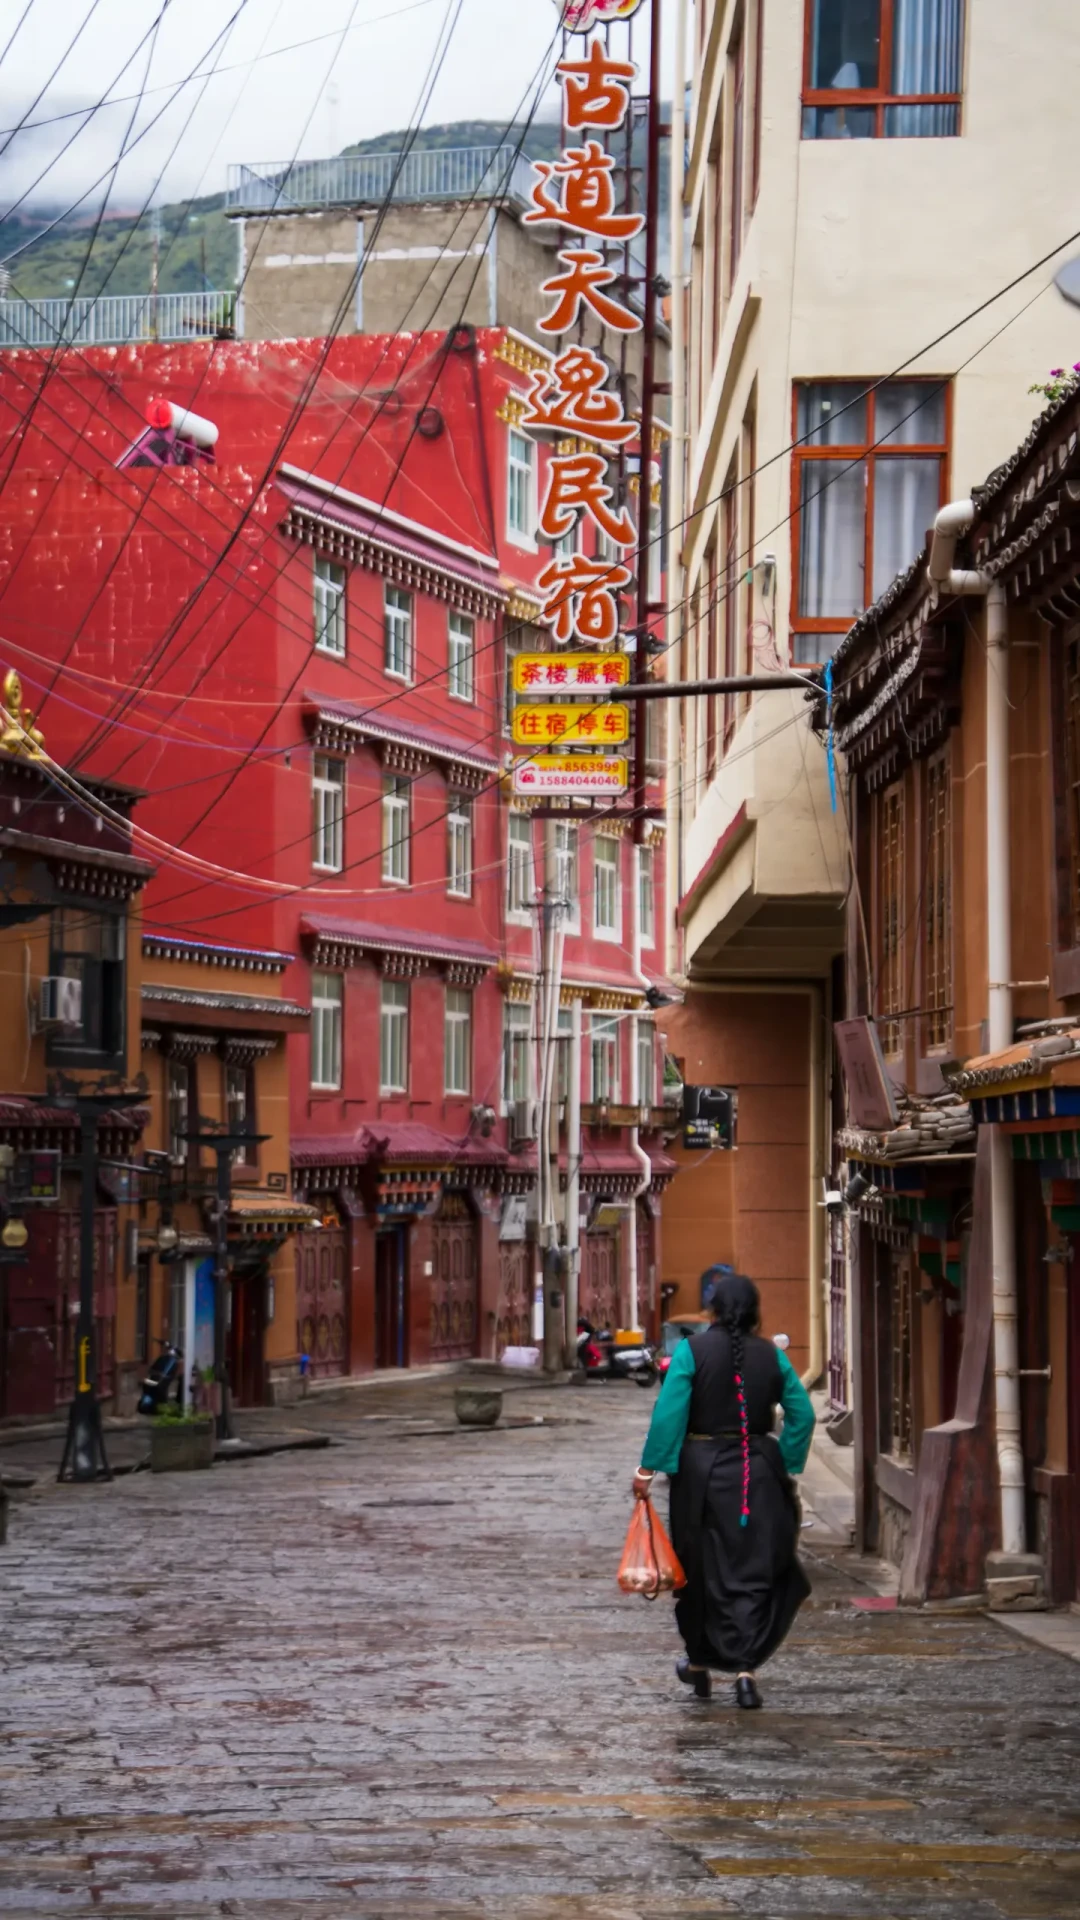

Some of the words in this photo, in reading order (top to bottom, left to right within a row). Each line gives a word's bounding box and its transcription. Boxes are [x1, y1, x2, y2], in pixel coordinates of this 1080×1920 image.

[523, 39, 644, 641] 古道天逸民宿
[521, 662, 568, 685] 茶楼
[576, 661, 624, 684] 藏餐
[520, 713, 567, 735] 住宿
[576, 713, 624, 735] 停车
